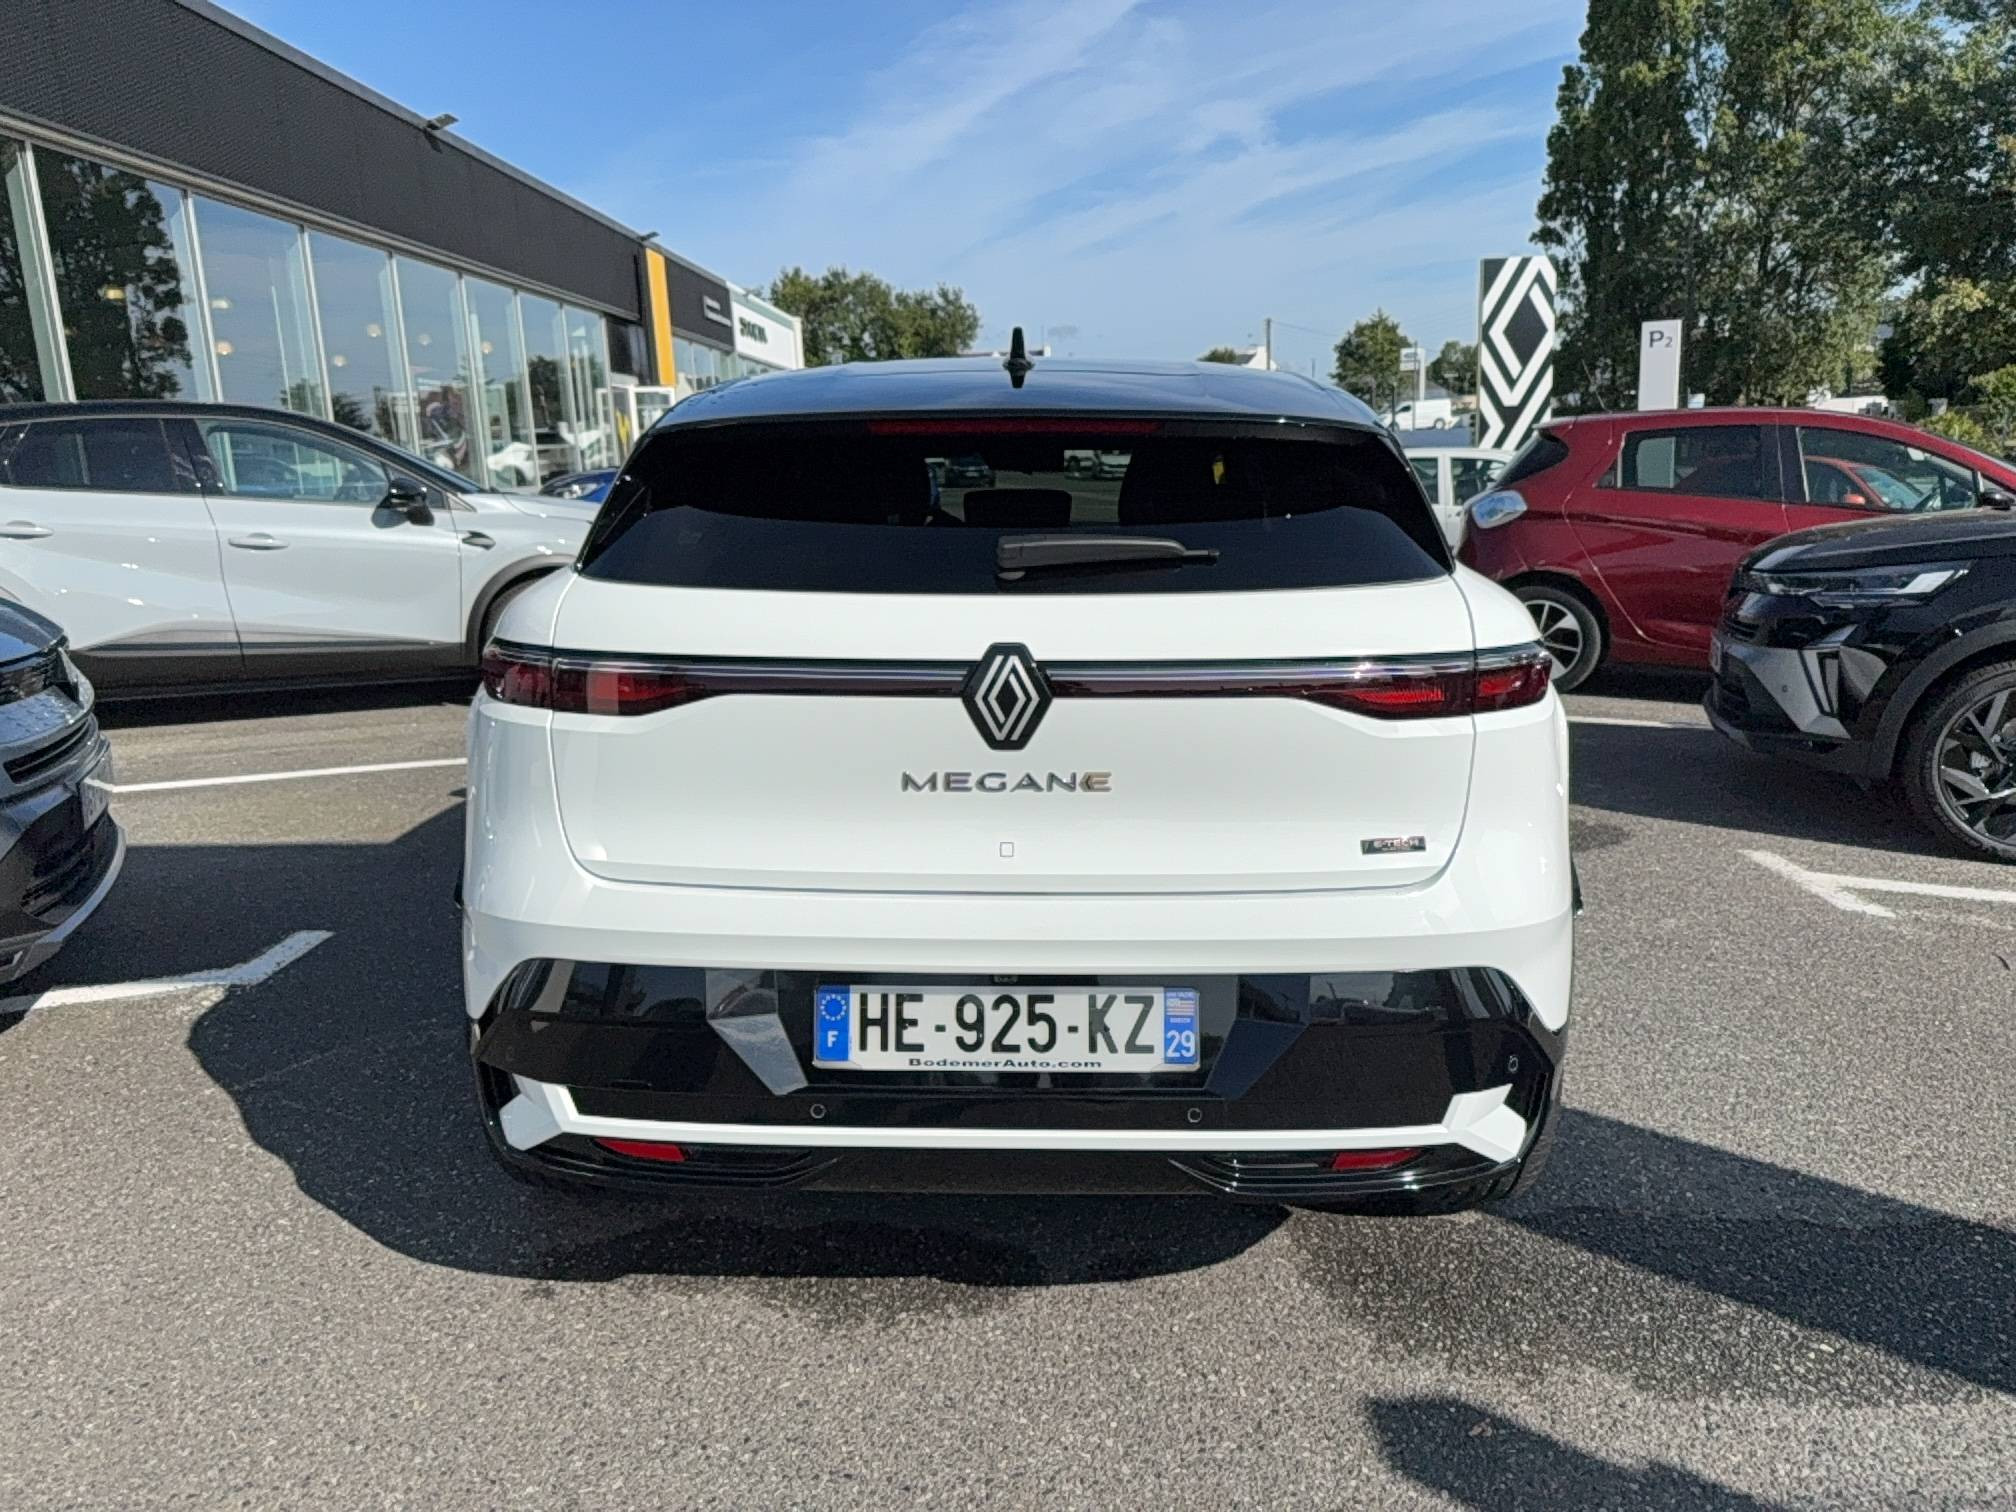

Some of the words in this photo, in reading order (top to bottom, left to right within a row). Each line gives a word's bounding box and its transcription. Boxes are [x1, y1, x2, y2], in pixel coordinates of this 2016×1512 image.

[902, 772, 1112, 793] MEGANE
[859, 993, 1155, 1054] HE-925-KZ
[827, 1031, 839, 1048] F
[1166, 1030, 1195, 1057] 29
[908, 1058, 1102, 1069] BodemerAuto.com
